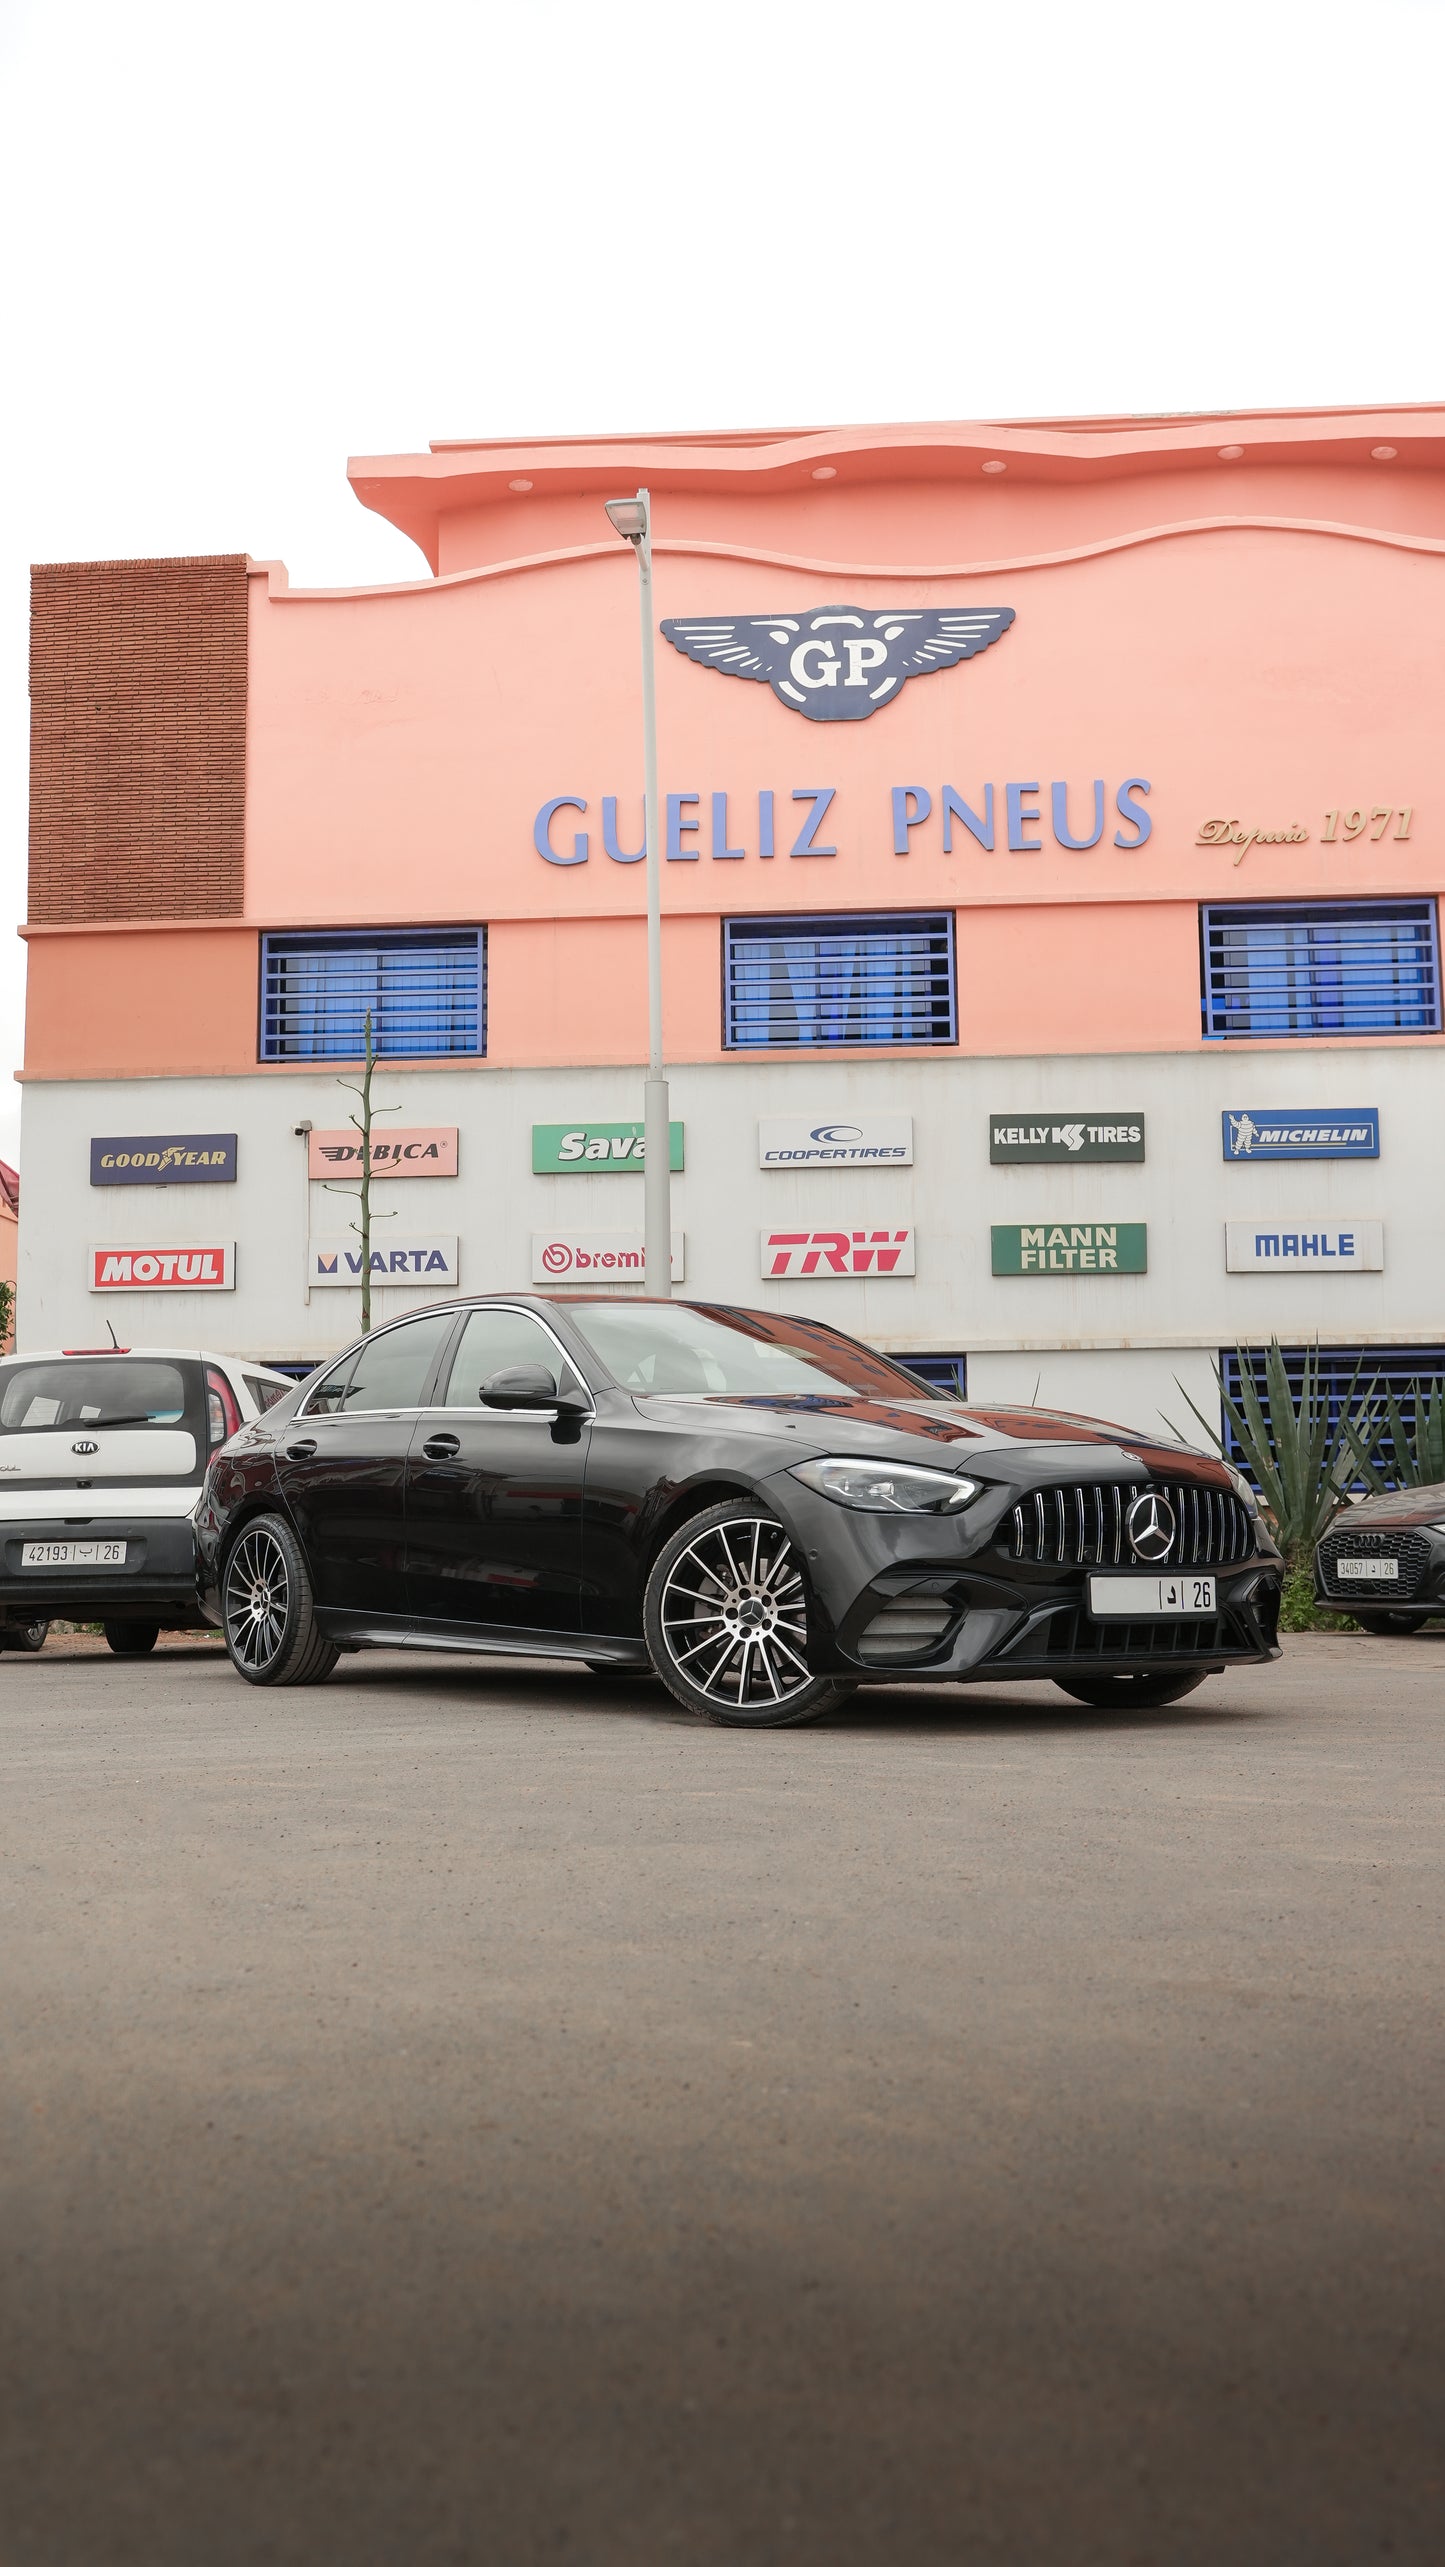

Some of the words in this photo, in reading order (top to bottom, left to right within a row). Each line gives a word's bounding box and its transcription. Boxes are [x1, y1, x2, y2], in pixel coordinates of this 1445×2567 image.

[789, 638, 888, 688] GP
[533, 788, 837, 866] GUELIZ
[891, 778, 1153, 855] PNEUS
[1195, 817, 1309, 867] Depuis
[1320, 807, 1413, 842] 1971
[993, 1127, 1050, 1145] KELLY
[1086, 1125, 1141, 1143] TIRES
[1259, 1128, 1369, 1143] MICHELIN
[1020, 1226, 1118, 1247] MANN
[1255, 1233, 1355, 1257] MAHLE
[344, 1250, 449, 1273] VARTA
[576, 1247, 673, 1268] brem
[767, 1230, 909, 1275] TRW
[1020, 1249, 1118, 1269] FILTER
[100, 1253, 219, 1282] MOTUL
[74, 1442, 95, 1452] KIA
[29, 1545, 68, 1561] 42193
[103, 1545, 120, 1560] 26
[1340, 1562, 1363, 1575] 34057
[1384, 1562, 1395, 1575] 26
[1193, 1581, 1211, 1608] 26
